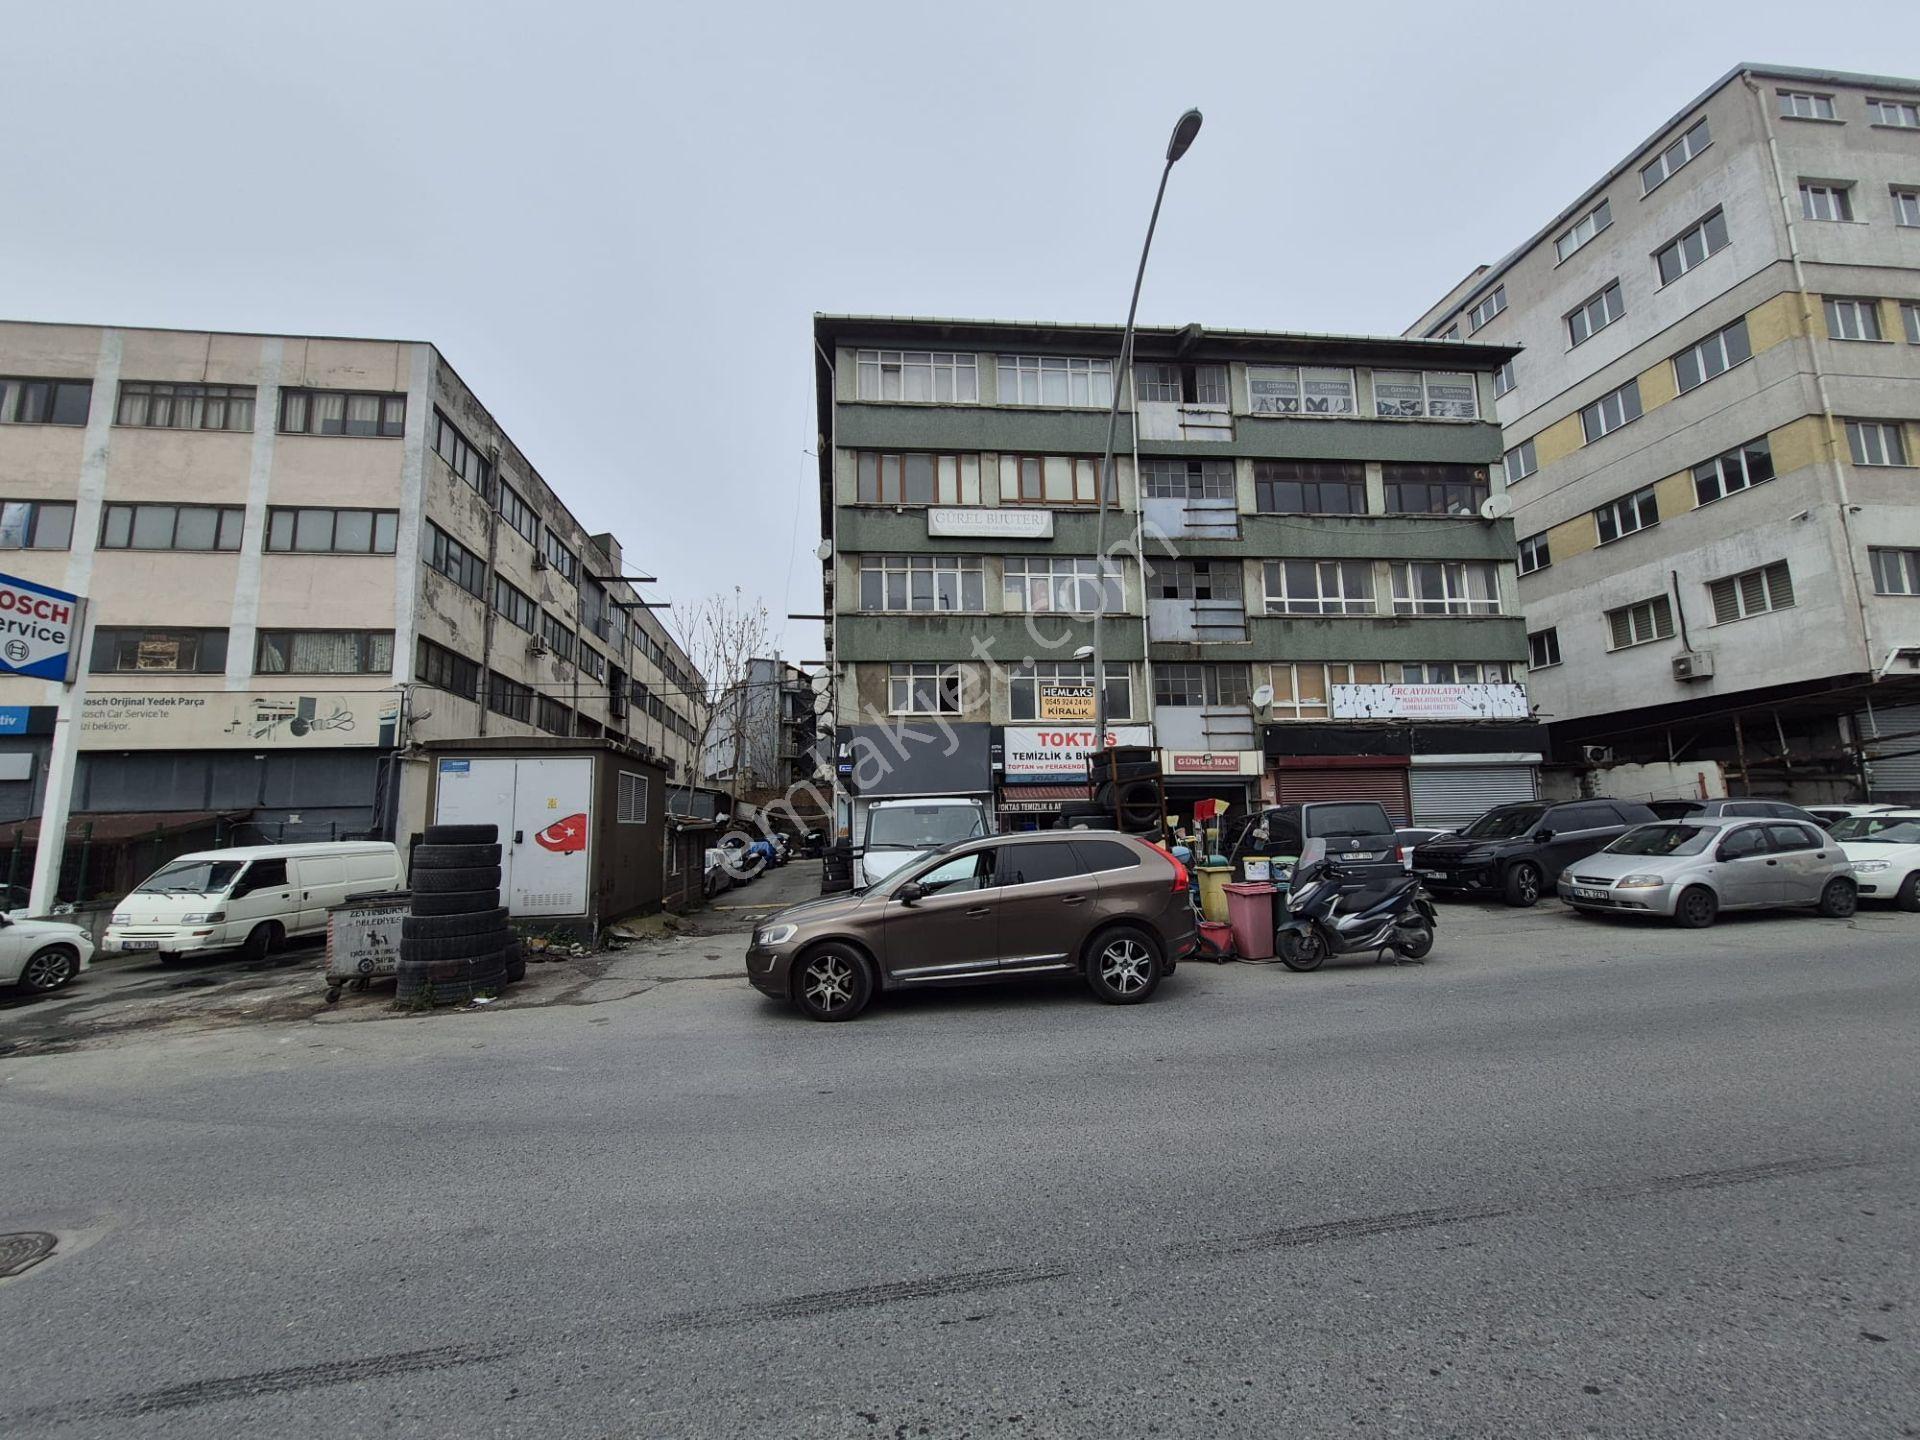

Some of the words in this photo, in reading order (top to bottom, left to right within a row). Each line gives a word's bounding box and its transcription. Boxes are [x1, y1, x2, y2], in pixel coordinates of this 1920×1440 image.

[1043, 688, 1093, 697] HEMLAKS
[1409, 687, 1466, 695] AYDINLATMA
[83, 697, 108, 706] osch
[110, 697, 145, 708] Orijinal
[147, 697, 176, 706] Yedek
[178, 697, 205, 708] Parça
[82, 709, 105, 719] osch
[107, 709, 122, 718] Car
[1048, 706, 1089, 715] KİRALIK
[1012, 750, 1061, 760] TEMİZLİK
[1065, 752, 1072, 760] &
[1214, 758, 1236, 766] HAN
